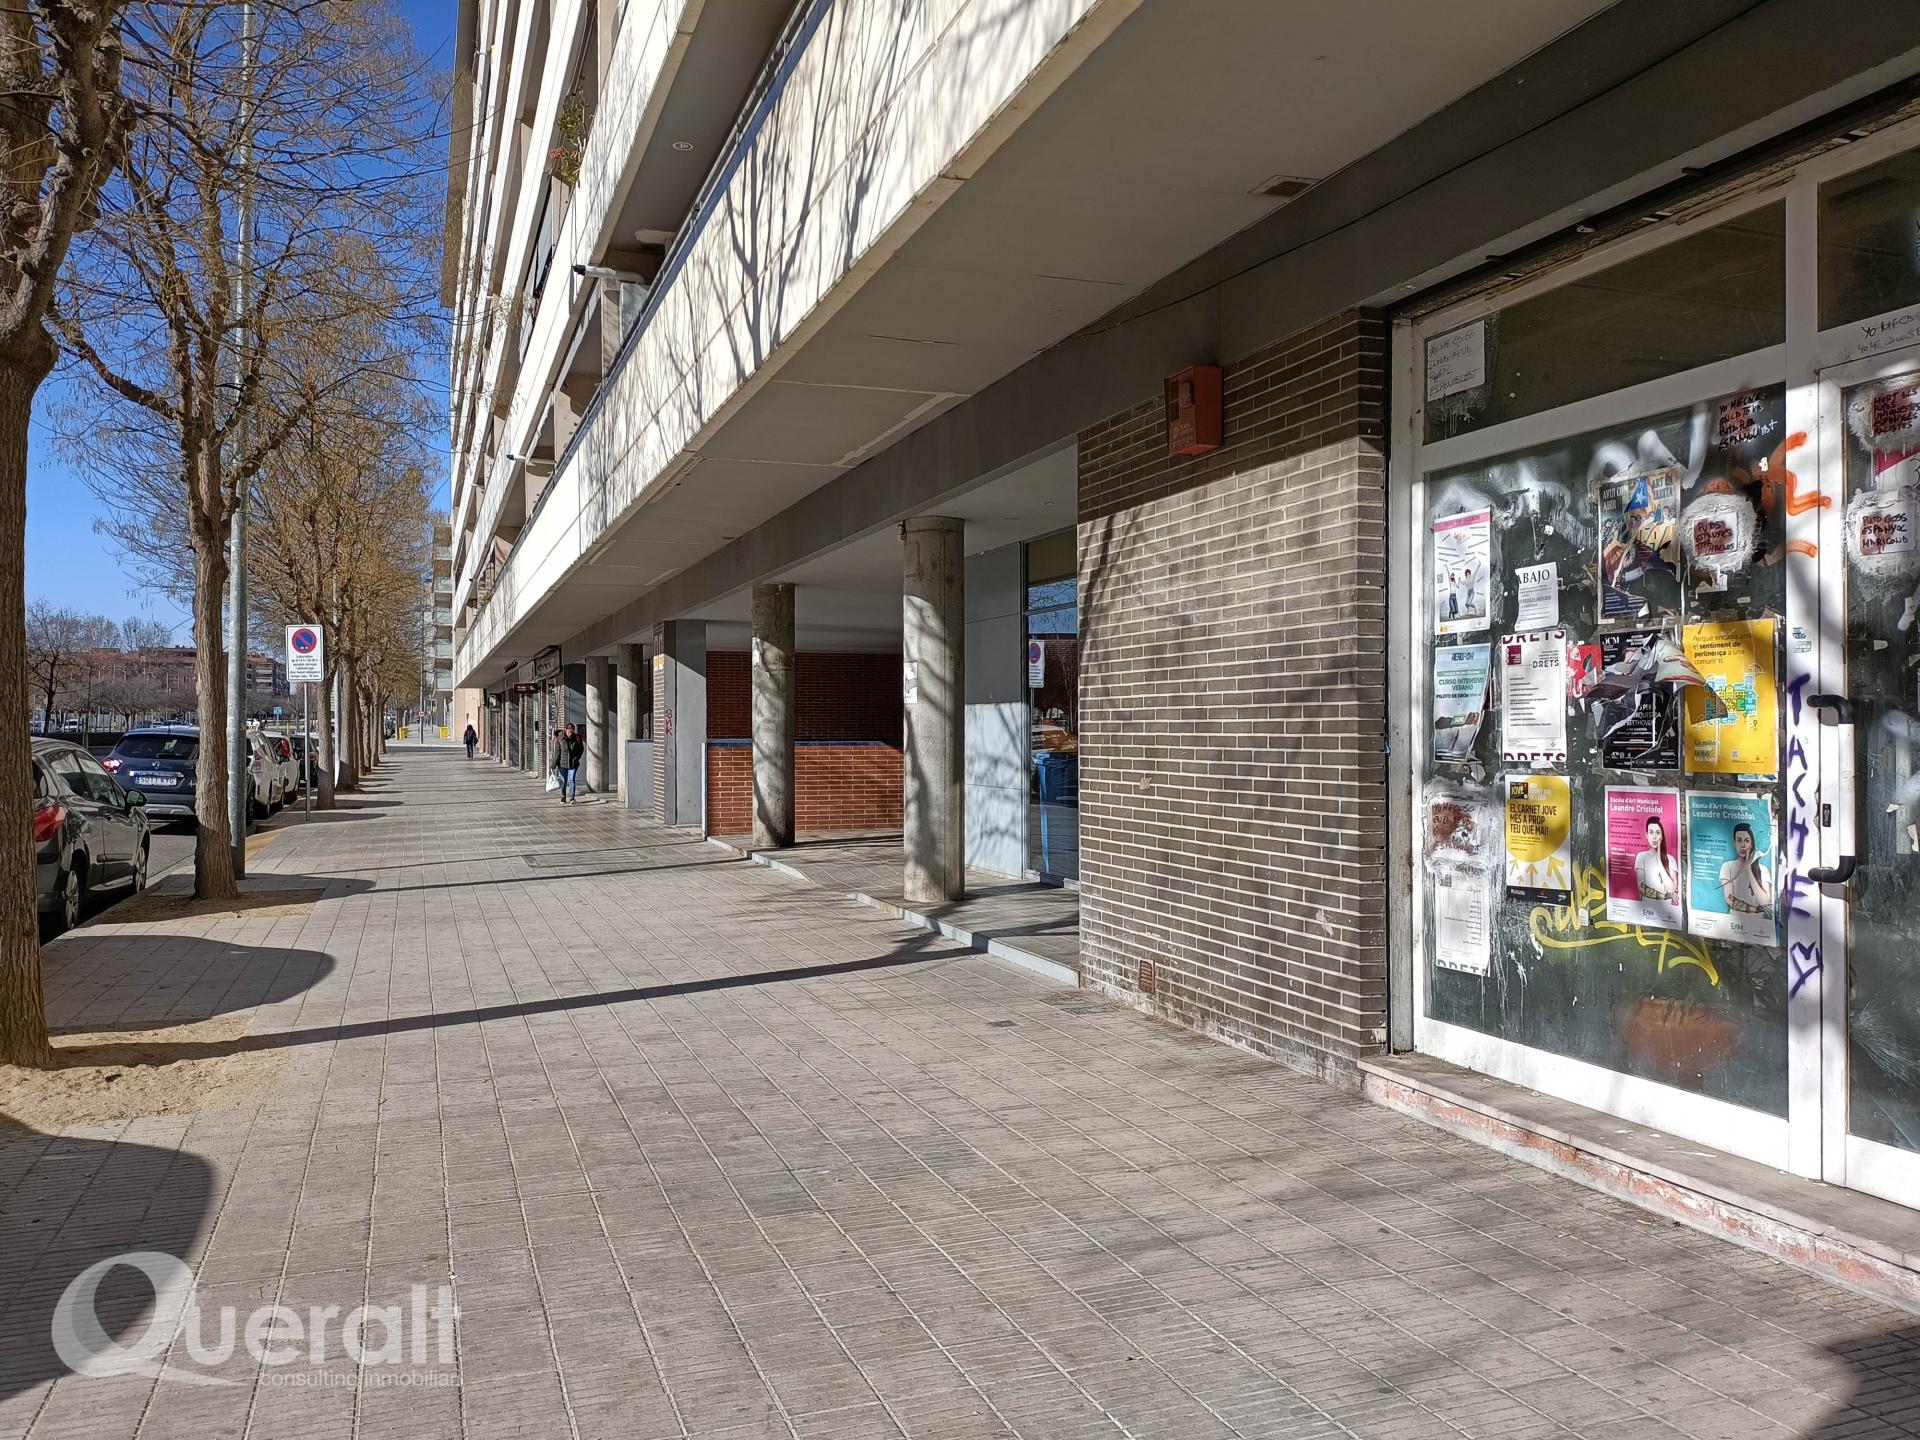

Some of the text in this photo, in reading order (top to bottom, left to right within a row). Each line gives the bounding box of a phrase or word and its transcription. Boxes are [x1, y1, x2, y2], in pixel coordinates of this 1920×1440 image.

[1699, 641, 1732, 650] sentiment
[1733, 640, 1742, 648] de
[1532, 659, 1560, 669] DRETS
[1509, 803, 1558, 816] EL CARNET JOVE
[1609, 804, 1635, 813] Leandre
[1692, 810, 1721, 819] Leandre
[1528, 815, 1546, 825] PROP
[1509, 823, 1521, 834] TEU
[1521, 825, 1534, 835] QUE
